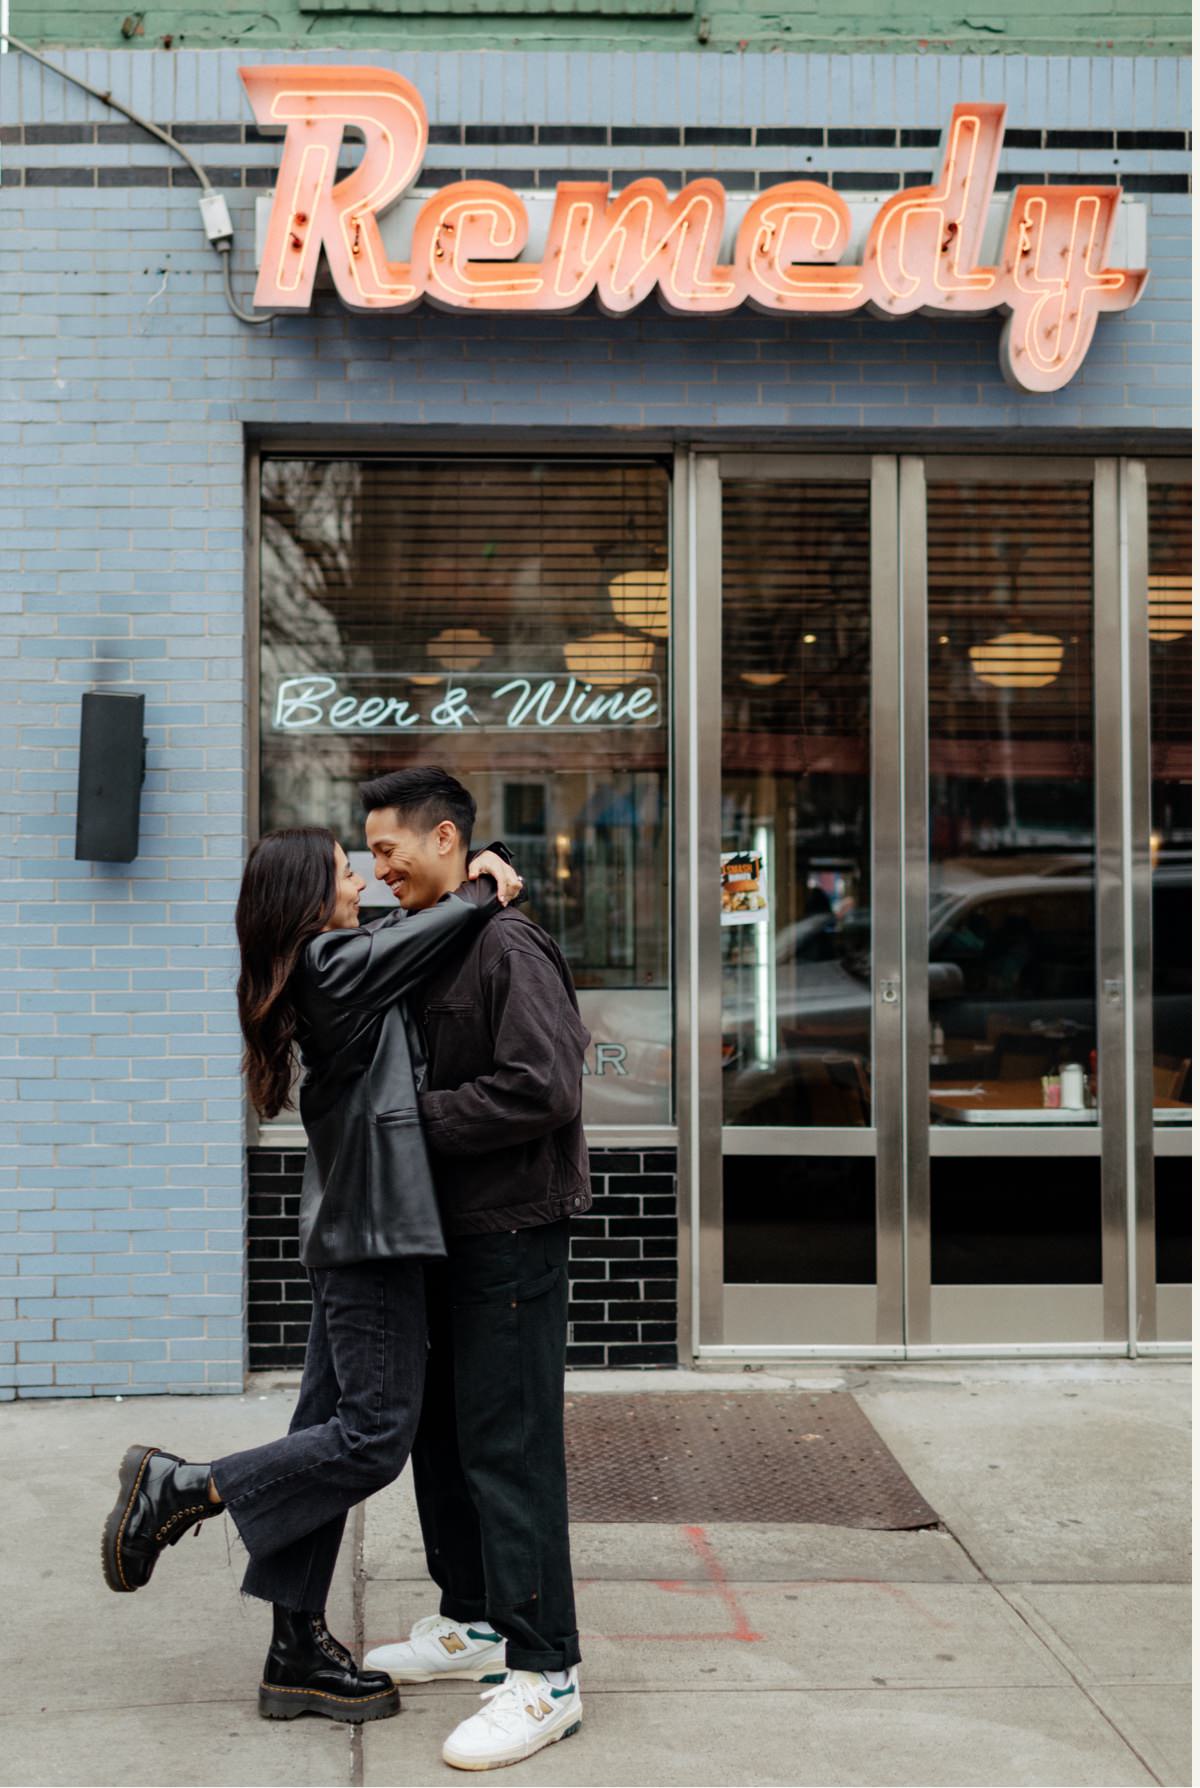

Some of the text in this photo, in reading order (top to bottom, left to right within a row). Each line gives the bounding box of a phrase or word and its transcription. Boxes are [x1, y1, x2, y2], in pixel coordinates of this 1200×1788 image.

[237, 65, 1151, 393] Remedy
[273, 676, 659, 729] Beer & Wine
